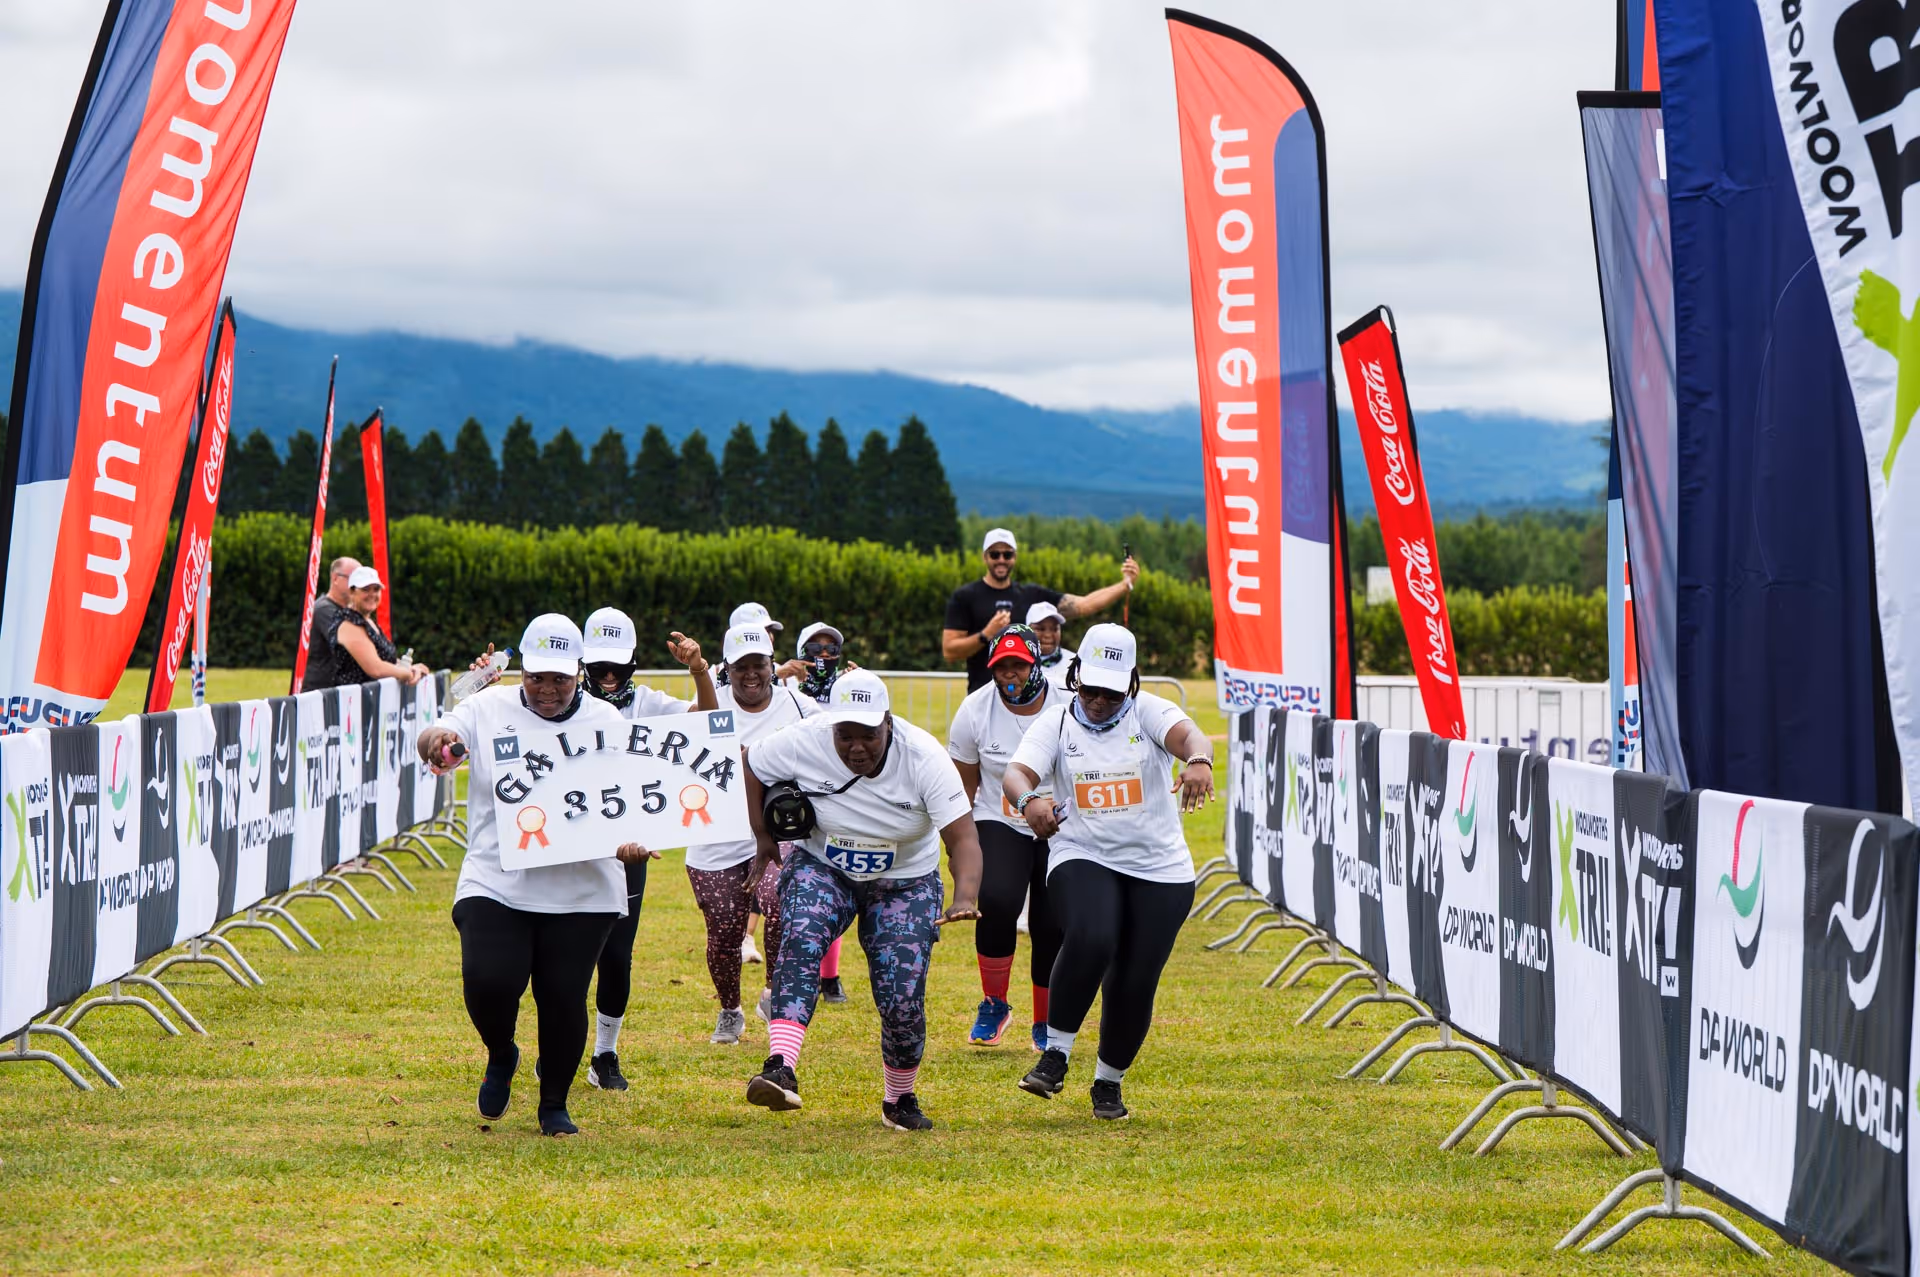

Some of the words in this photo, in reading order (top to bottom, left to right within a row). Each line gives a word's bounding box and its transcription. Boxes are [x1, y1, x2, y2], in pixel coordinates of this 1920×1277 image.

[713, 716, 729, 728] W
[498, 742, 514, 754] W
[564, 779, 667, 821] 355
[1087, 783, 1130, 808] 611
[1575, 809, 1609, 842] WOOLWORTHS
[831, 851, 888, 873] 453
[1443, 905, 1460, 944] DP
[1460, 907, 1495, 954] WORLD
[1503, 917, 1516, 961] DP
[1516, 922, 1549, 973] WORLD
[1723, 1016, 1787, 1093] WORLD
[1808, 1048, 1834, 1113] DP
[1832, 1059, 1904, 1154] WORLD
